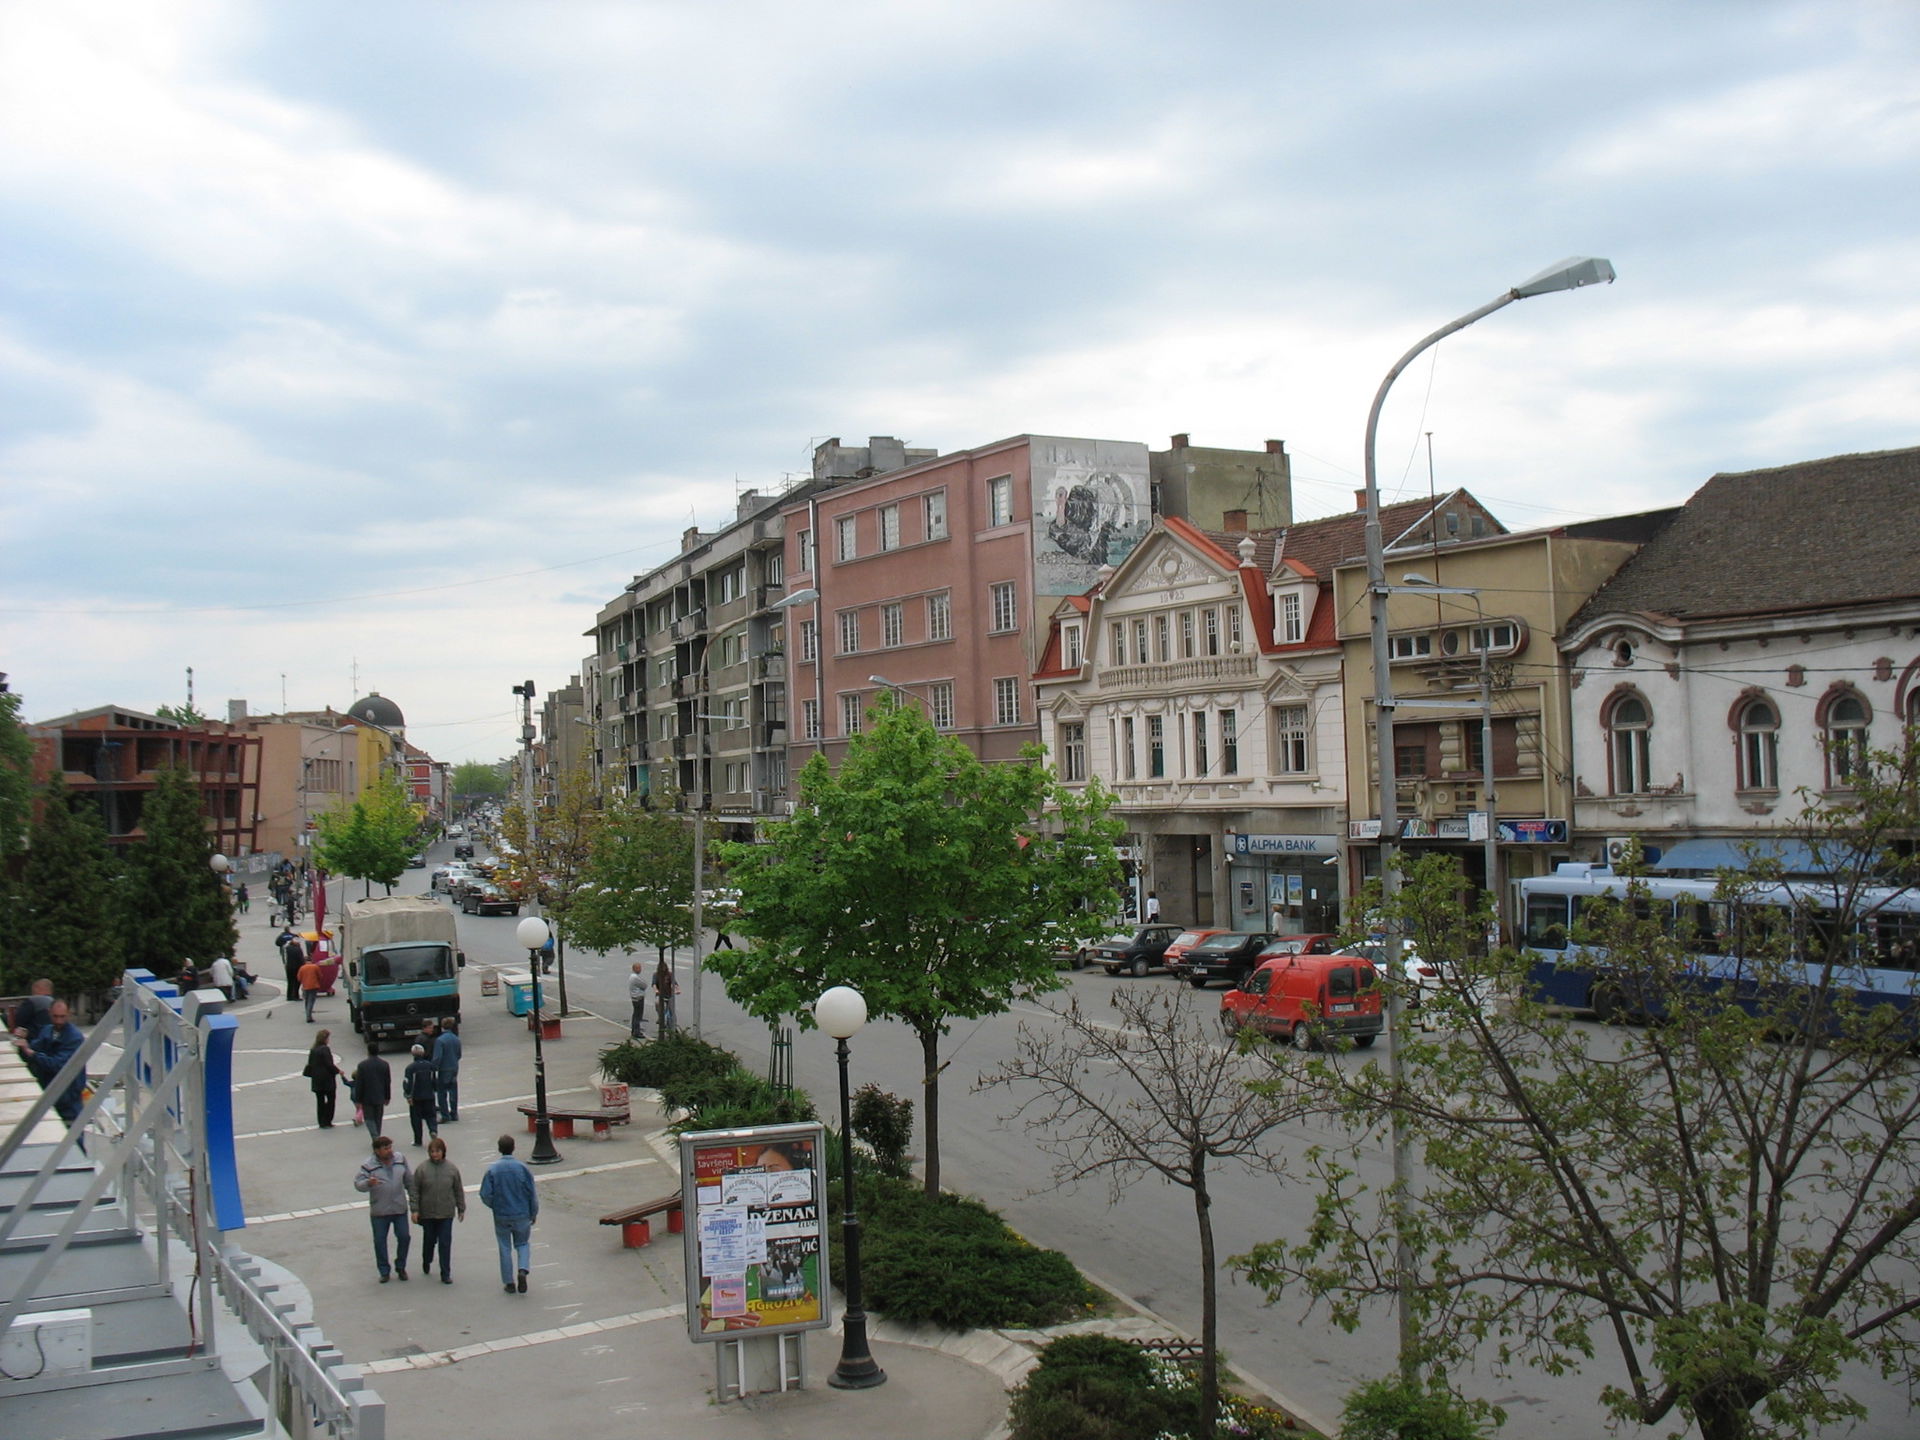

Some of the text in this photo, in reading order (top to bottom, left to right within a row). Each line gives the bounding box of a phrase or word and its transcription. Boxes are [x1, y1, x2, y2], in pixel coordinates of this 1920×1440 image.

[1250, 839, 1317, 851] ALPHA BANK
[750, 1206, 816, 1222] DŽENAN
